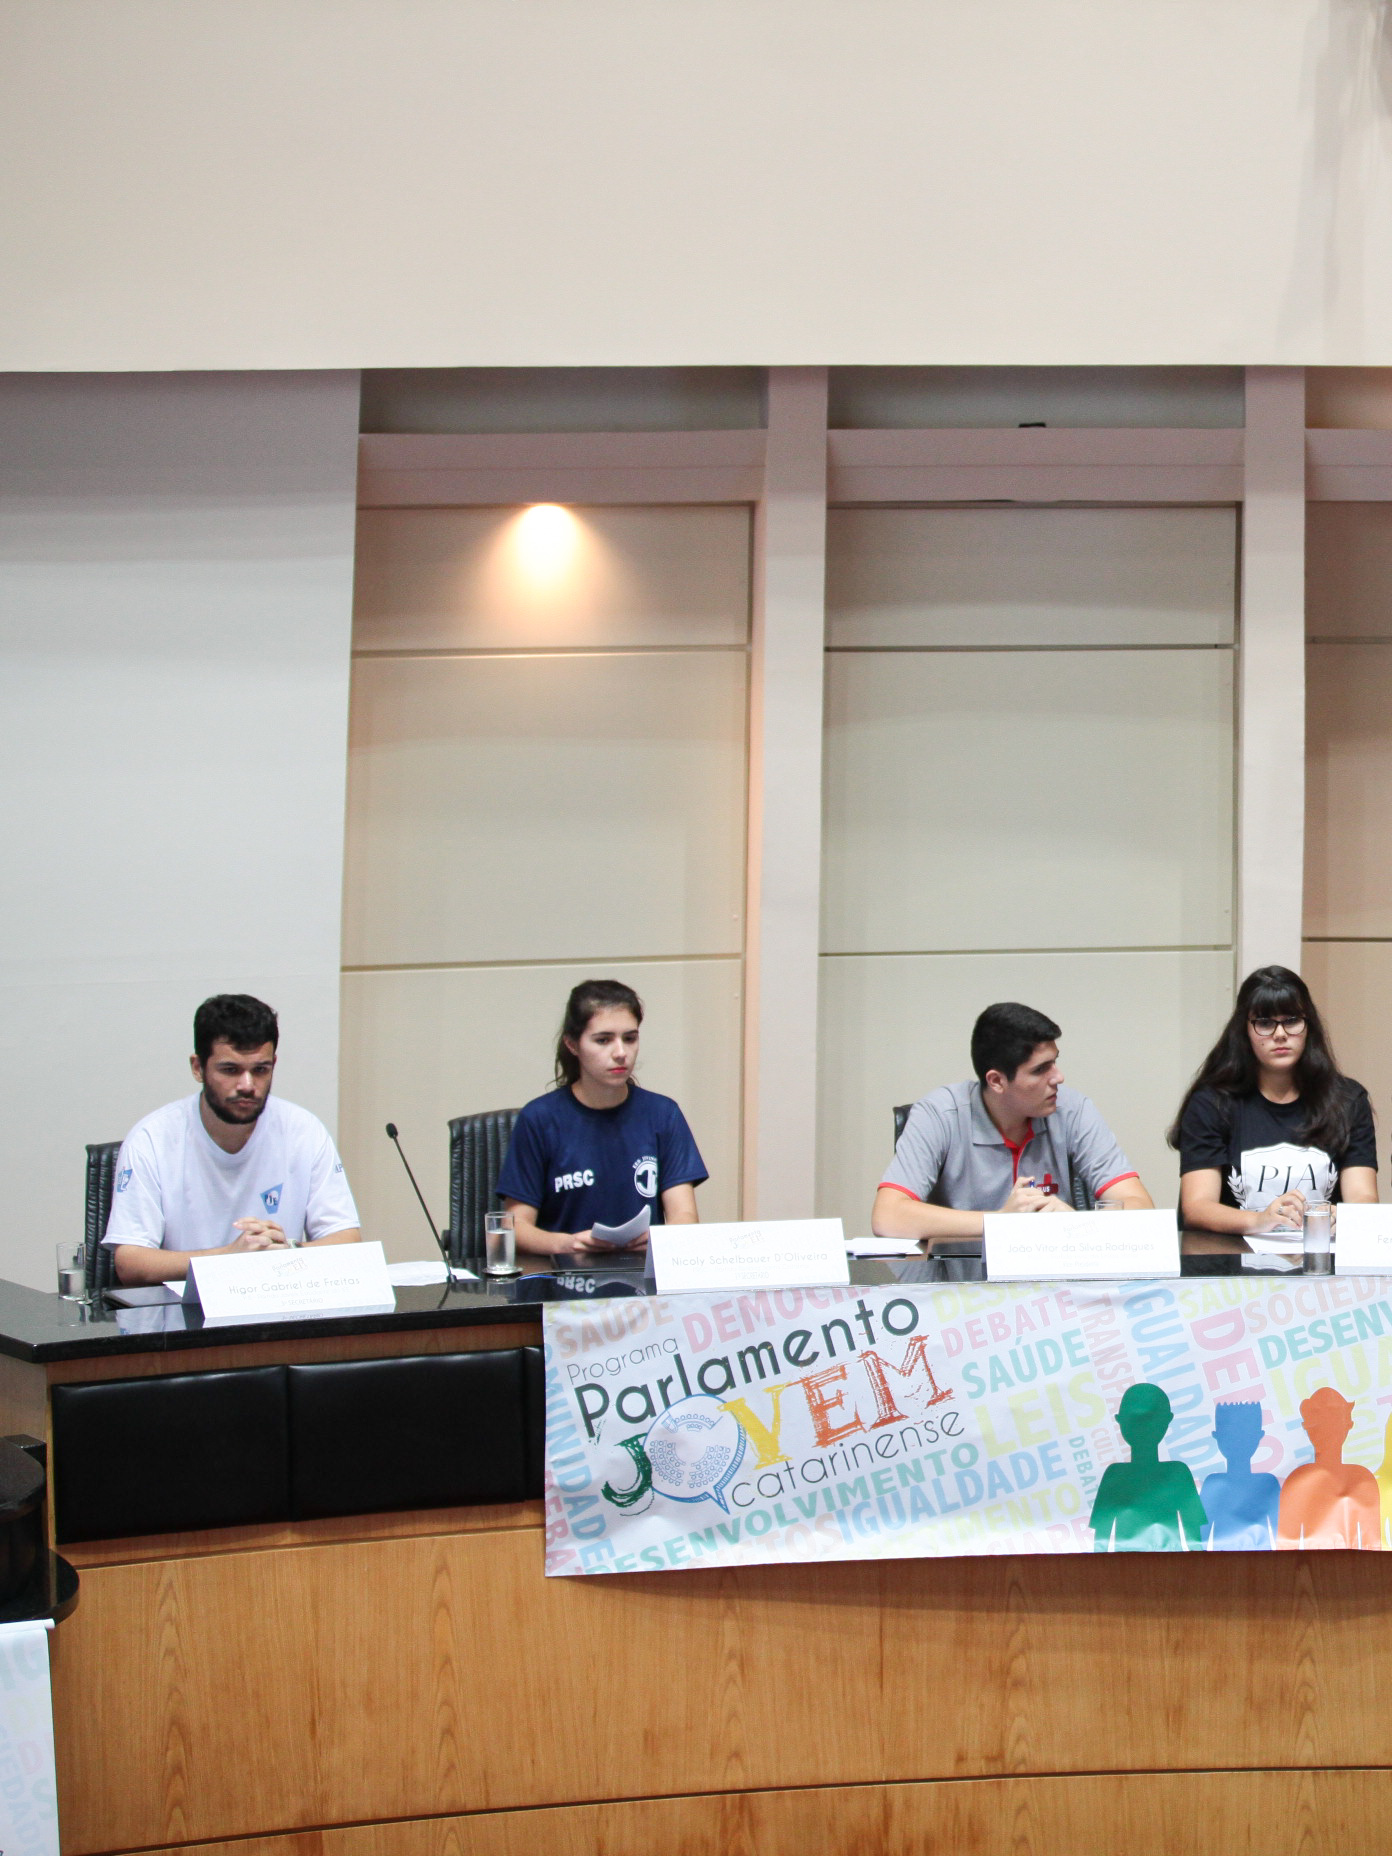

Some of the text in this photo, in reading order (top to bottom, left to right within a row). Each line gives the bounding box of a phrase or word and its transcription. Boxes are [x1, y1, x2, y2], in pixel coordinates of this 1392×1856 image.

[554, 1169, 595, 1193] PRSC
[1257, 1163, 1319, 1196] PJA
[672, 1252, 828, 1267] Nicoly Schelbauer D'Oliveira
[1008, 1242, 1155, 1254] João Vitor da Silva Rodrigues
[228, 1284, 258, 1296] Higor
[261, 1280, 303, 1292] Gabriel
[306, 1279, 321, 1289] de
[324, 1276, 361, 1287] Freitas
[941, 1289, 1081, 1358] DEBATE
[566, 1337, 679, 1385] Programa
[573, 1298, 920, 1438] Parlamento
[961, 1327, 1091, 1400] SAÚDE
[601, 1334, 956, 1517] JOVEM
[974, 1371, 1108, 1459] LEIS
[581, 1442, 980, 1573] ESENVOLVIMENTO
[834, 1440, 1069, 1545] IGUALDADE
